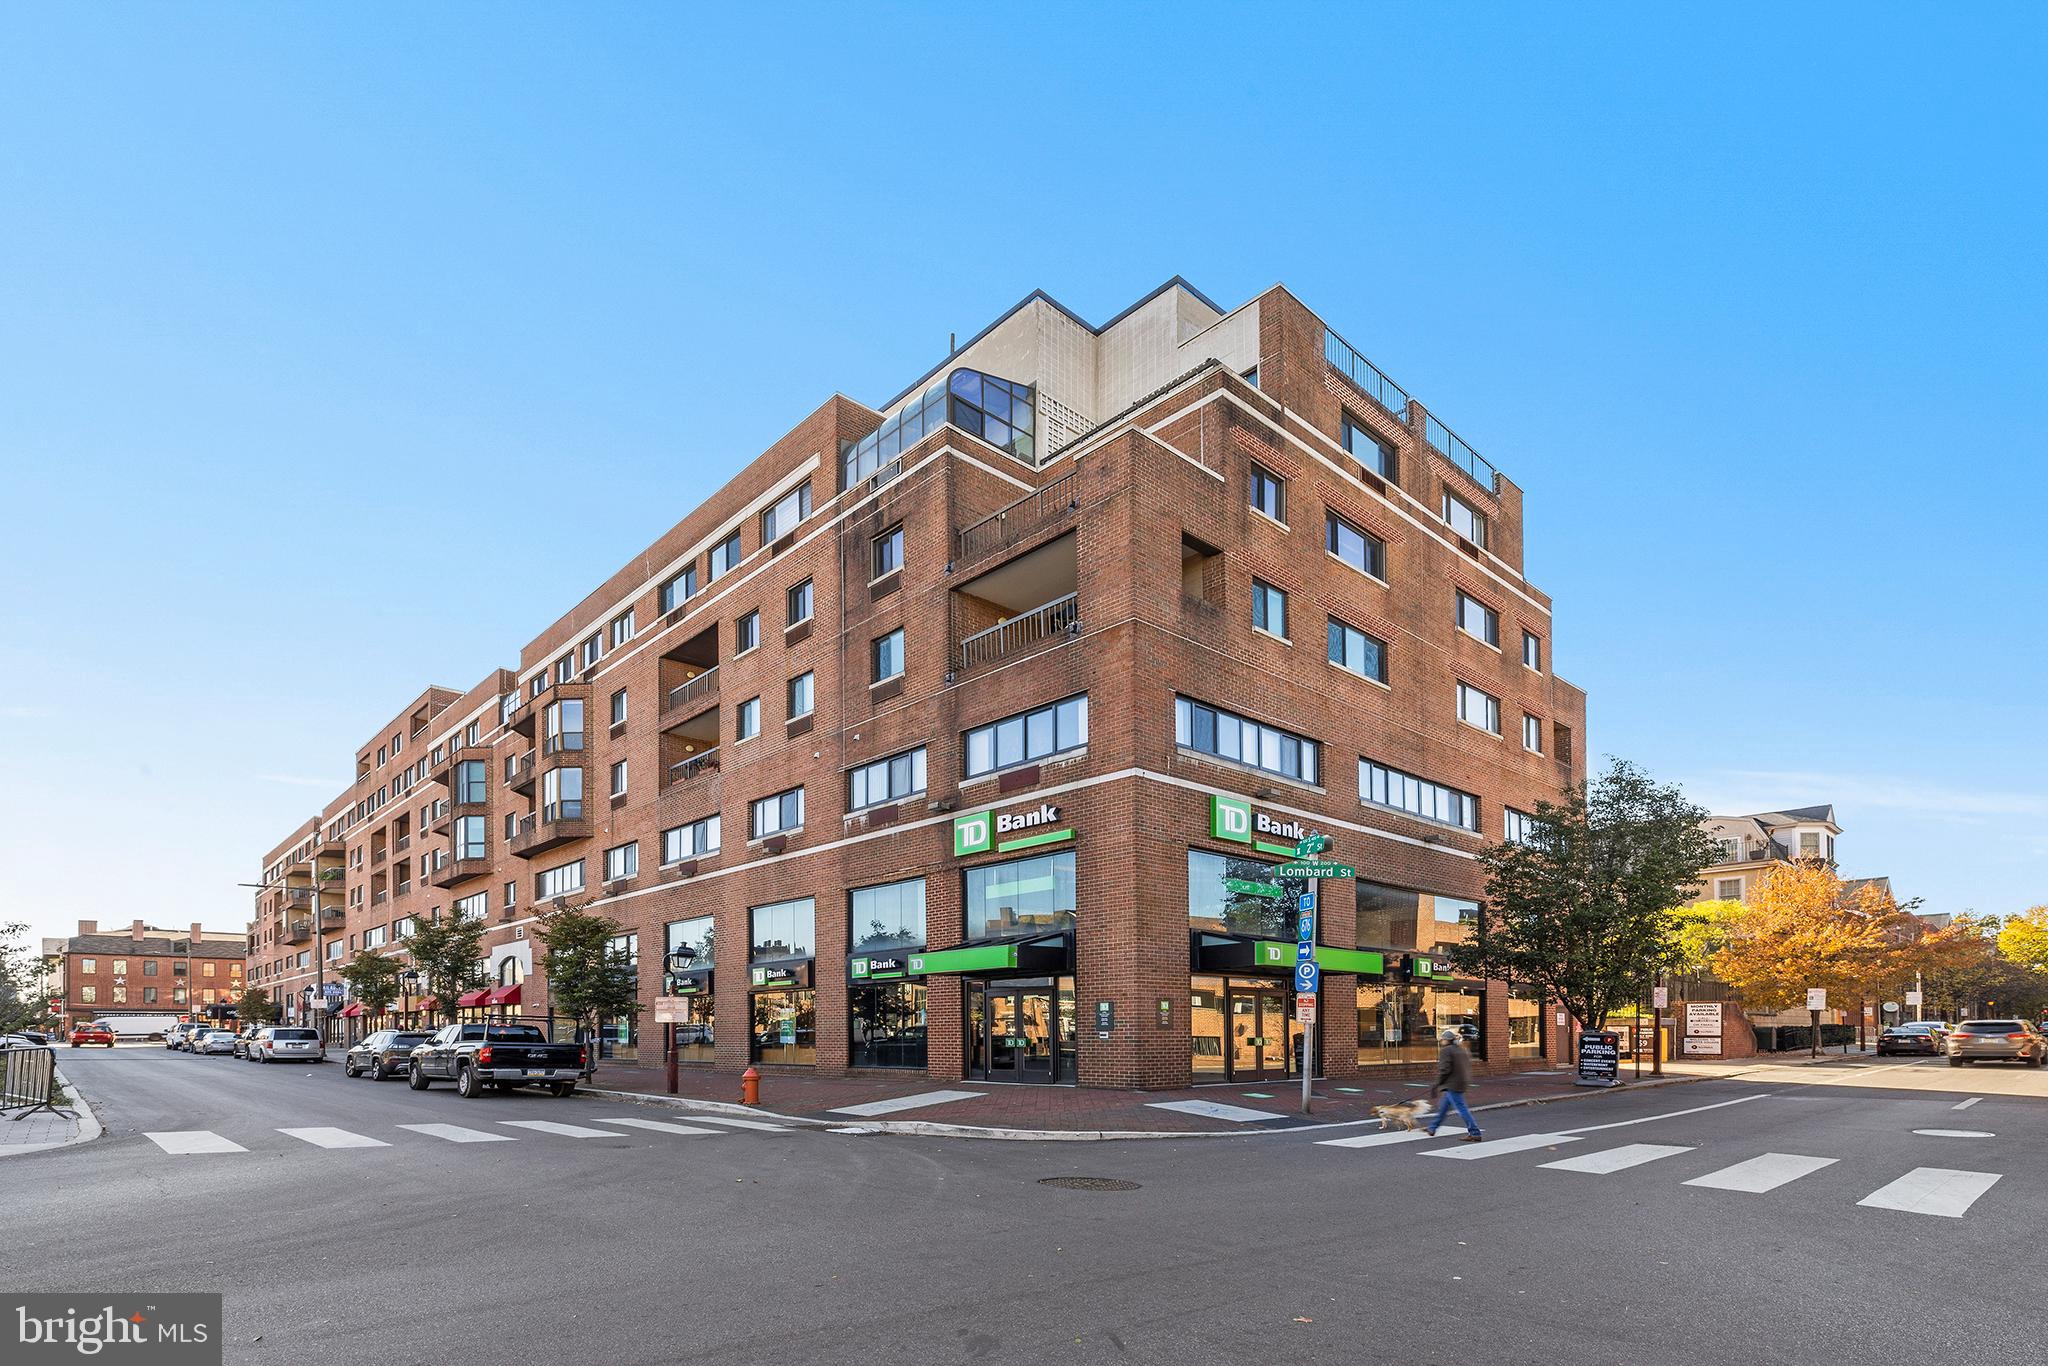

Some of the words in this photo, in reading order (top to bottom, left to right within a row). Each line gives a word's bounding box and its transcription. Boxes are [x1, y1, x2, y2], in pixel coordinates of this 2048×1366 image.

[957, 820, 987, 847] TD
[997, 803, 1057, 833] Bank
[1219, 804, 1248, 834] TD
[1257, 813, 1305, 840] Bank
[1280, 866, 1334, 877] Lombard
[1340, 868, 1352, 877] St
[1303, 897, 1310, 906] TO
[1301, 919, 1311, 932] 676
[1267, 947, 1281, 960] TD
[853, 961, 866, 974] TD
[870, 958, 896, 970] Bank
[911, 958, 923, 970] TD
[1419, 961, 1430, 973] TD
[753, 972, 764, 982] TD
[766, 969, 787, 979] Bank
[1303, 967, 1311, 975] P
[676, 977, 692, 986] Bank
